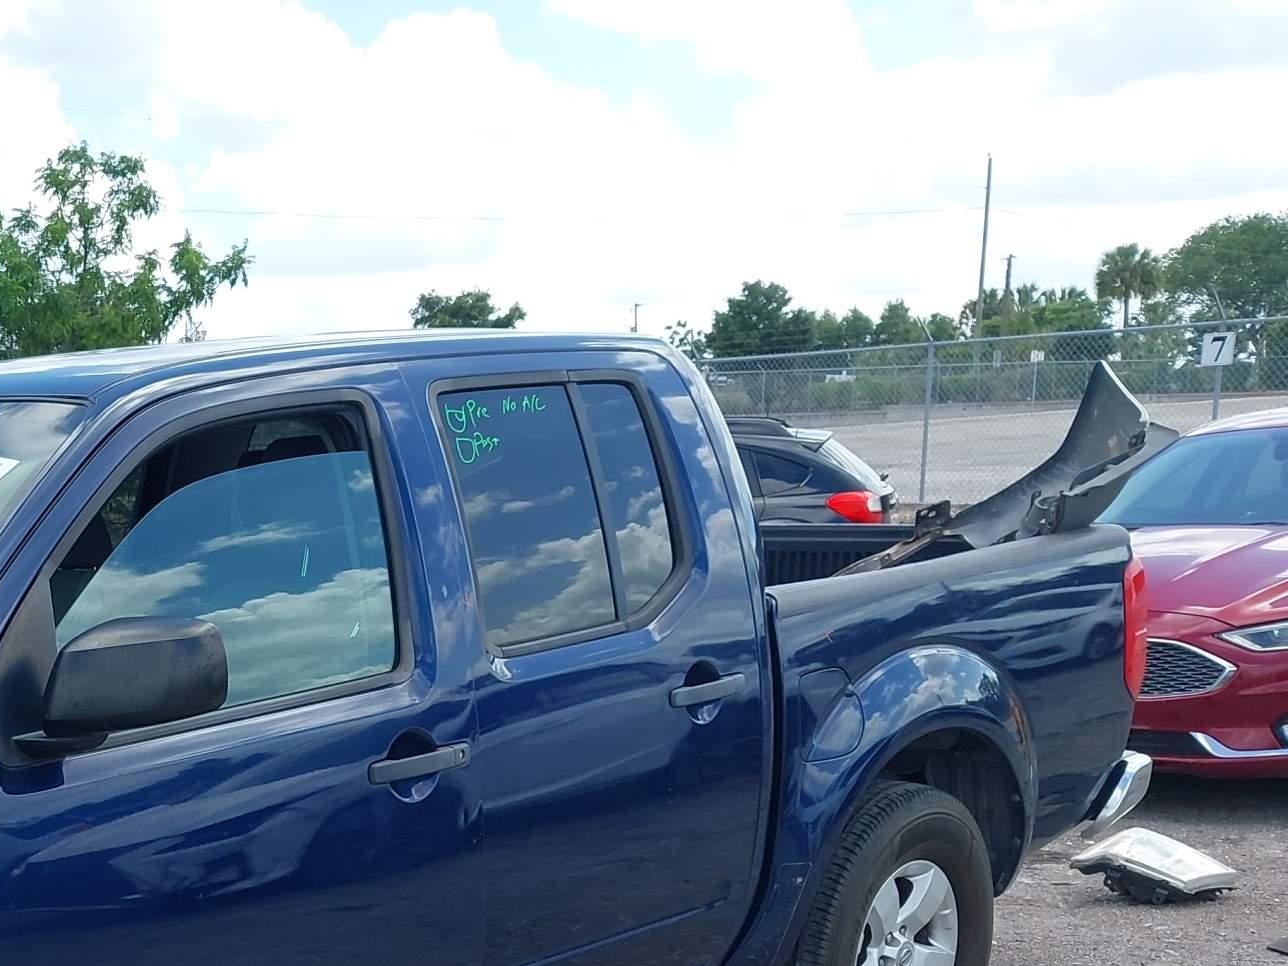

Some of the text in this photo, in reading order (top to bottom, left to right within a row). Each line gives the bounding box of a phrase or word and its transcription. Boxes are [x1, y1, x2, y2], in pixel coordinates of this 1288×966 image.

[1212, 335, 1228, 362] 7
[466, 395, 547, 427] Pre No A/C
[474, 432, 500, 456] Post
